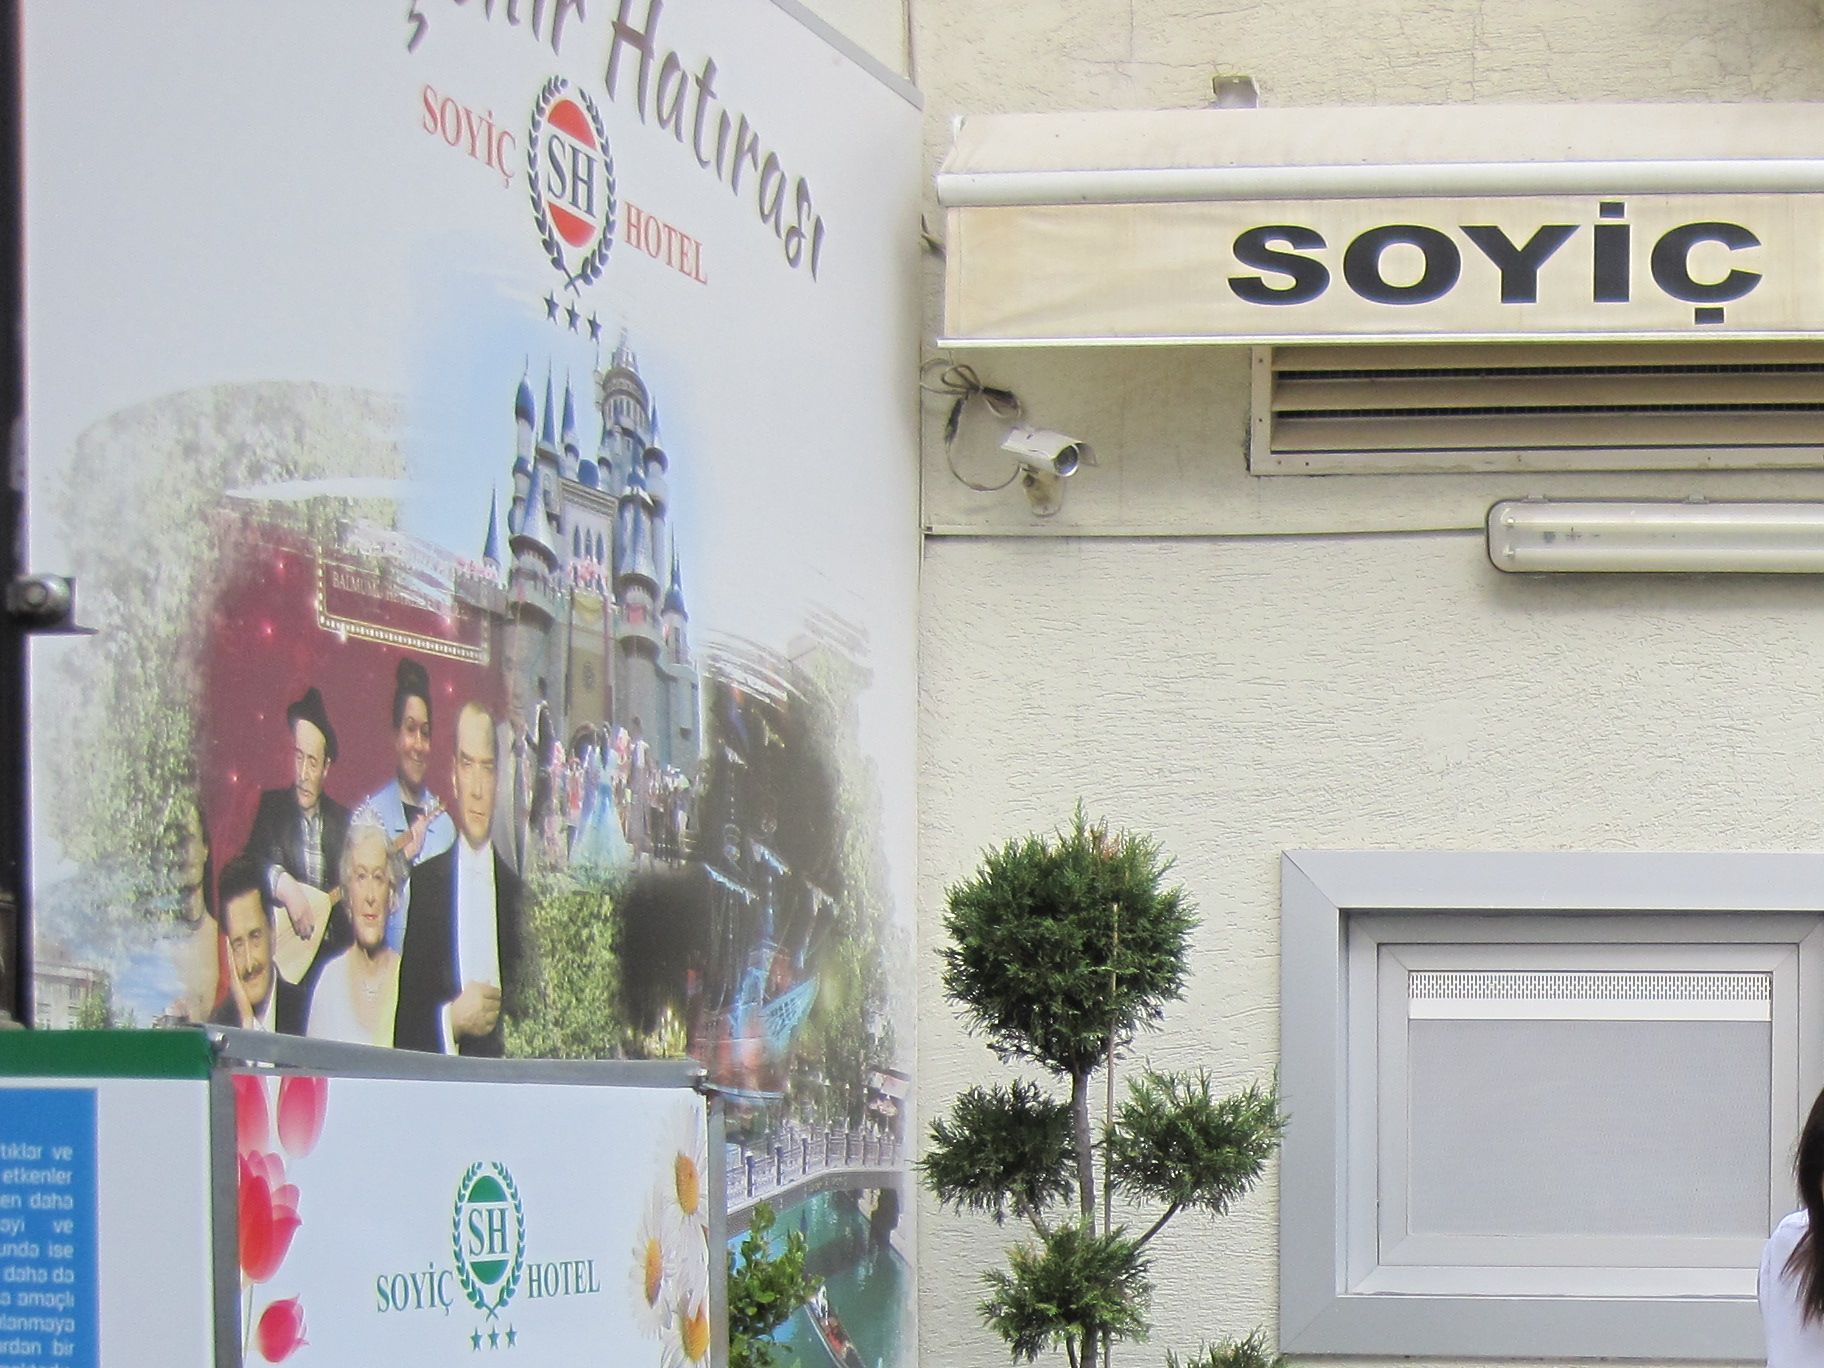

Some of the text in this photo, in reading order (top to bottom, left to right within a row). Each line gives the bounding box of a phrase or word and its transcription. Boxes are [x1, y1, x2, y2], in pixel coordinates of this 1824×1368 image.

[606, 0, 825, 282] Hatırası
[422, 84, 707, 285] SOYİÇ HOTEL
[547, 134, 597, 219] SH
[1227, 202, 1763, 325] SOYİÇ
[51, 1146, 73, 1161] ve
[2, 1167, 73, 1184] etkenler
[29, 1192, 73, 1210] daha
[53, 1219, 74, 1234] ve
[468, 1207, 510, 1257] SH
[47, 1241, 74, 1258] ise
[4, 1265, 75, 1283] daha da
[376, 1259, 600, 1315] SOYİÇ HOTEL
[17, 1292, 75, 1312] amaçlı
[52, 1338, 74, 1357] bir
